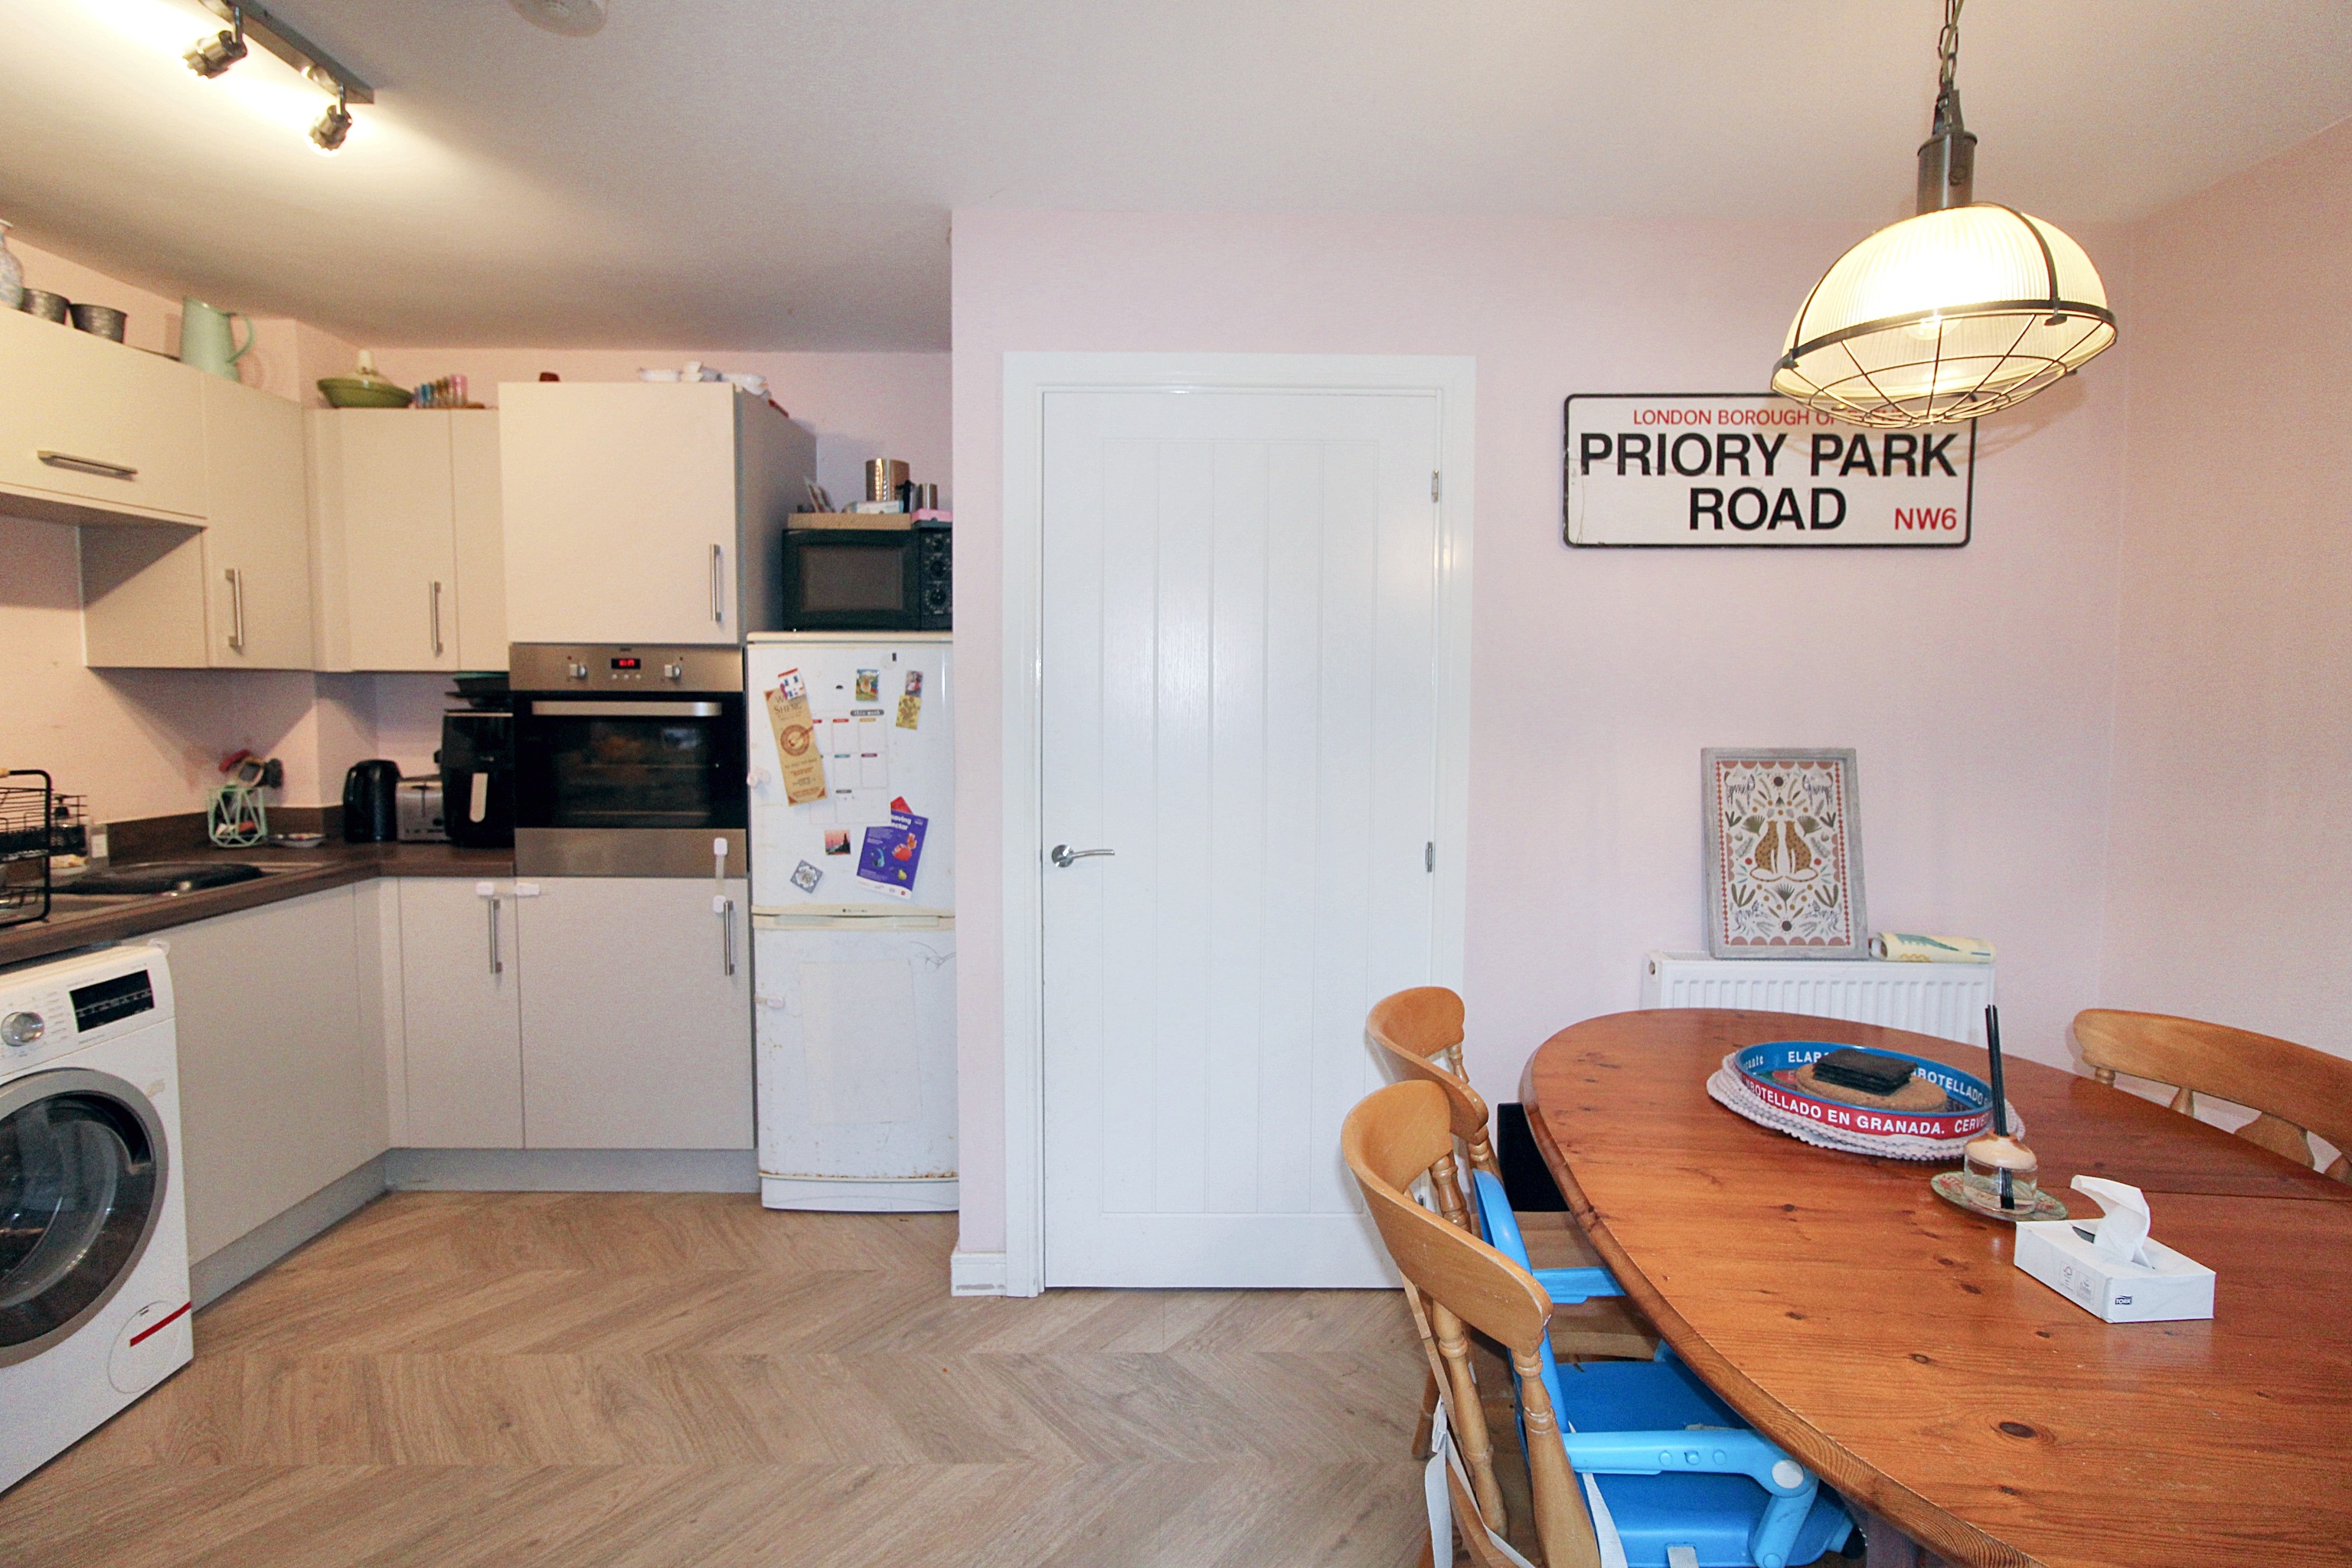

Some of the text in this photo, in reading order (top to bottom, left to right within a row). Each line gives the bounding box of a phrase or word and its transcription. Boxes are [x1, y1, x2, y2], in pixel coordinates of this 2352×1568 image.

[1634, 410, 1711, 426] LONDON
[1718, 410, 1810, 426] BOROUGH
[1580, 433, 1958, 477] PRIORY PARK
[1689, 487, 1847, 531] ROAD
[1894, 507, 1958, 531] NW6
[1827, 1109, 1851, 1125] EN
[1856, 1115, 1945, 1135] GRANADA.
